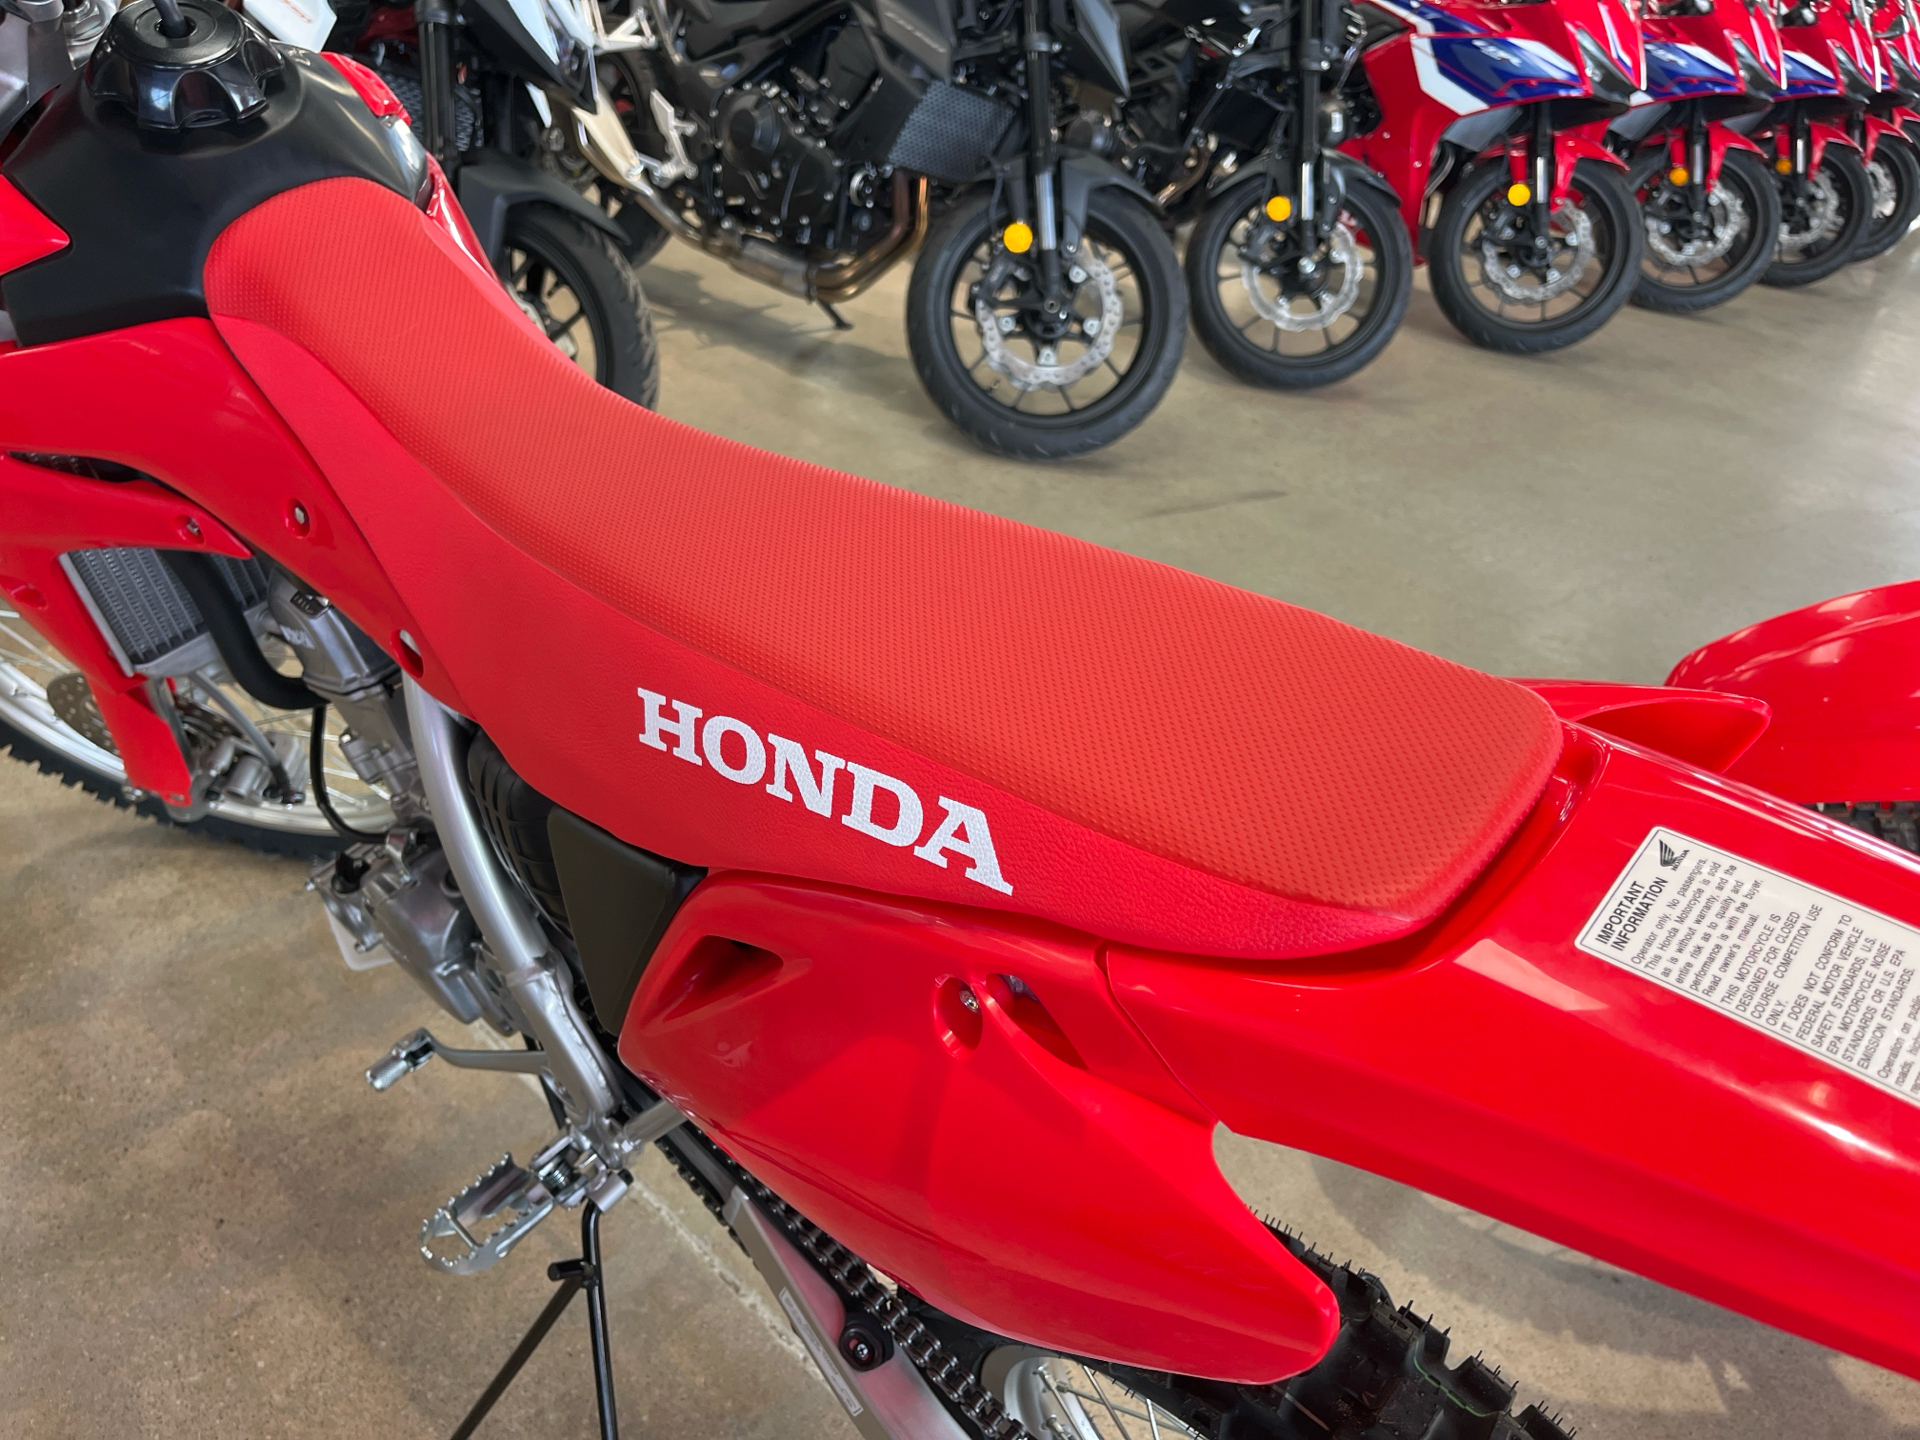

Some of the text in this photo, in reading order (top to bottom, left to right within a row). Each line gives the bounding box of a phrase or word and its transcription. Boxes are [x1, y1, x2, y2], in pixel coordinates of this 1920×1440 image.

[638, 688, 1013, 896] HONDA
[1595, 881, 1645, 945] IMPORTANT
[1631, 860, 1708, 964] Operator only. No passengers.
[1671, 850, 1690, 872] HONDA
[1611, 877, 1669, 951] INFORMATION
[1644, 955, 1662, 970] This
[1657, 928, 1680, 952] Honda
[1674, 888, 1705, 925] Motorcycle
[1708, 862, 1721, 877] sold
[1661, 865, 1737, 978] as is without warranty, and the
[1676, 880, 1744, 984] entire risk as to quality and
[1690, 944, 1723, 992] performance
[1725, 916, 1740, 931] with
[1735, 902, 1748, 914] the
[1743, 880, 1763, 900] buyer.
[1702, 914, 1760, 997] Read owner's manual.
[1720, 914, 1781, 1005] THIS MOTORCYCLE IS
[1735, 912, 1800, 1013] DESIGNED FOR CLOSED
[1751, 904, 1823, 1019] COURSE COMPETITION USE
[1766, 1000, 1788, 1026] ONLY.
[1781, 915, 1852, 1034] IT DOES NOT CONFORM TO
[1796, 927, 1864, 1041] FEDERAL MOTOR VEHICLE
[1811, 938, 1877, 1048] SAFETY STANDARDS, U.S.
[1826, 943, 1891, 1055] EPA MOTORCYCLE NOISE
[1842, 950, 1906, 1062] STANDARDS OR U.S. EPA
[1857, 969, 1915, 1070] EMISSION STANDARDS.
[1877, 1037, 1905, 1079] Operation
[1900, 1022, 1912, 1035] on
[1895, 1061, 1915, 1087] roads,
